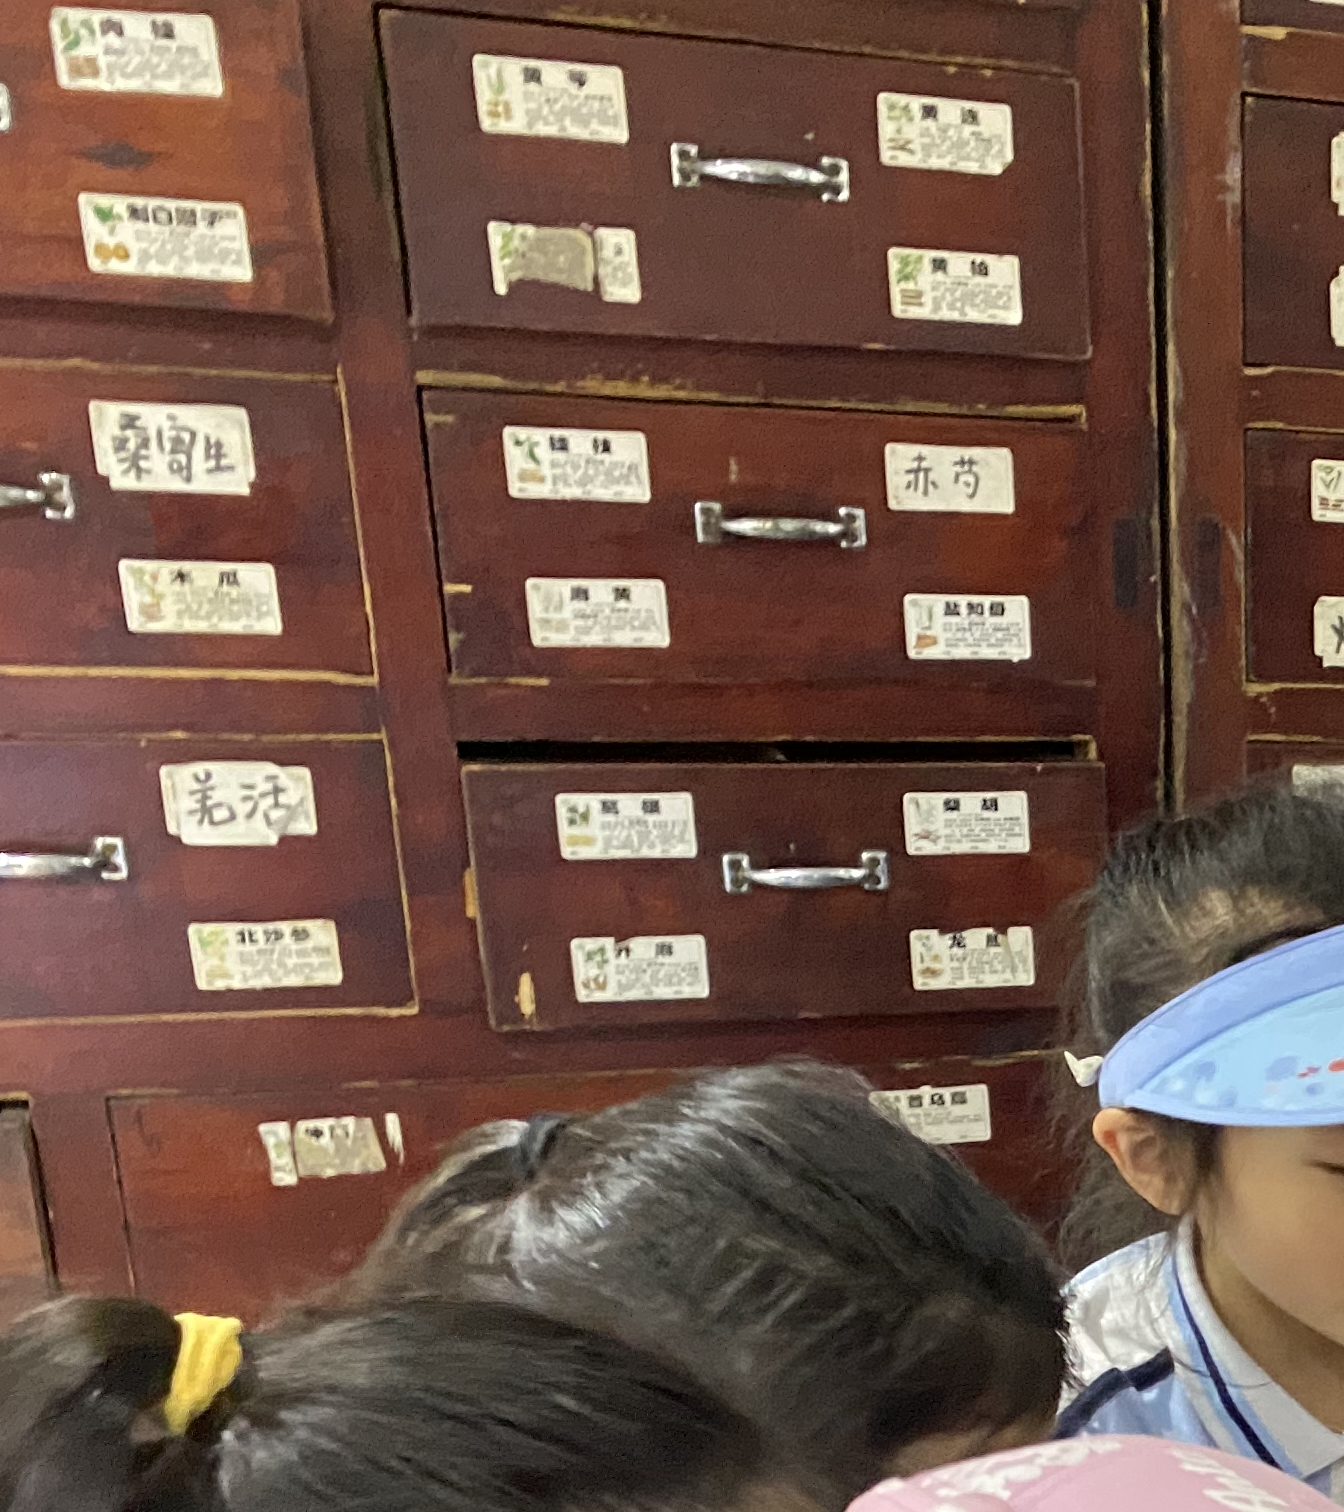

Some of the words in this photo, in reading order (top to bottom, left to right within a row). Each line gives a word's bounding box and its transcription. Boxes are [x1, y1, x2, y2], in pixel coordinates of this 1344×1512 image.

[113, 412, 236, 484] 桑寄生
[904, 452, 981, 500] 赤芍
